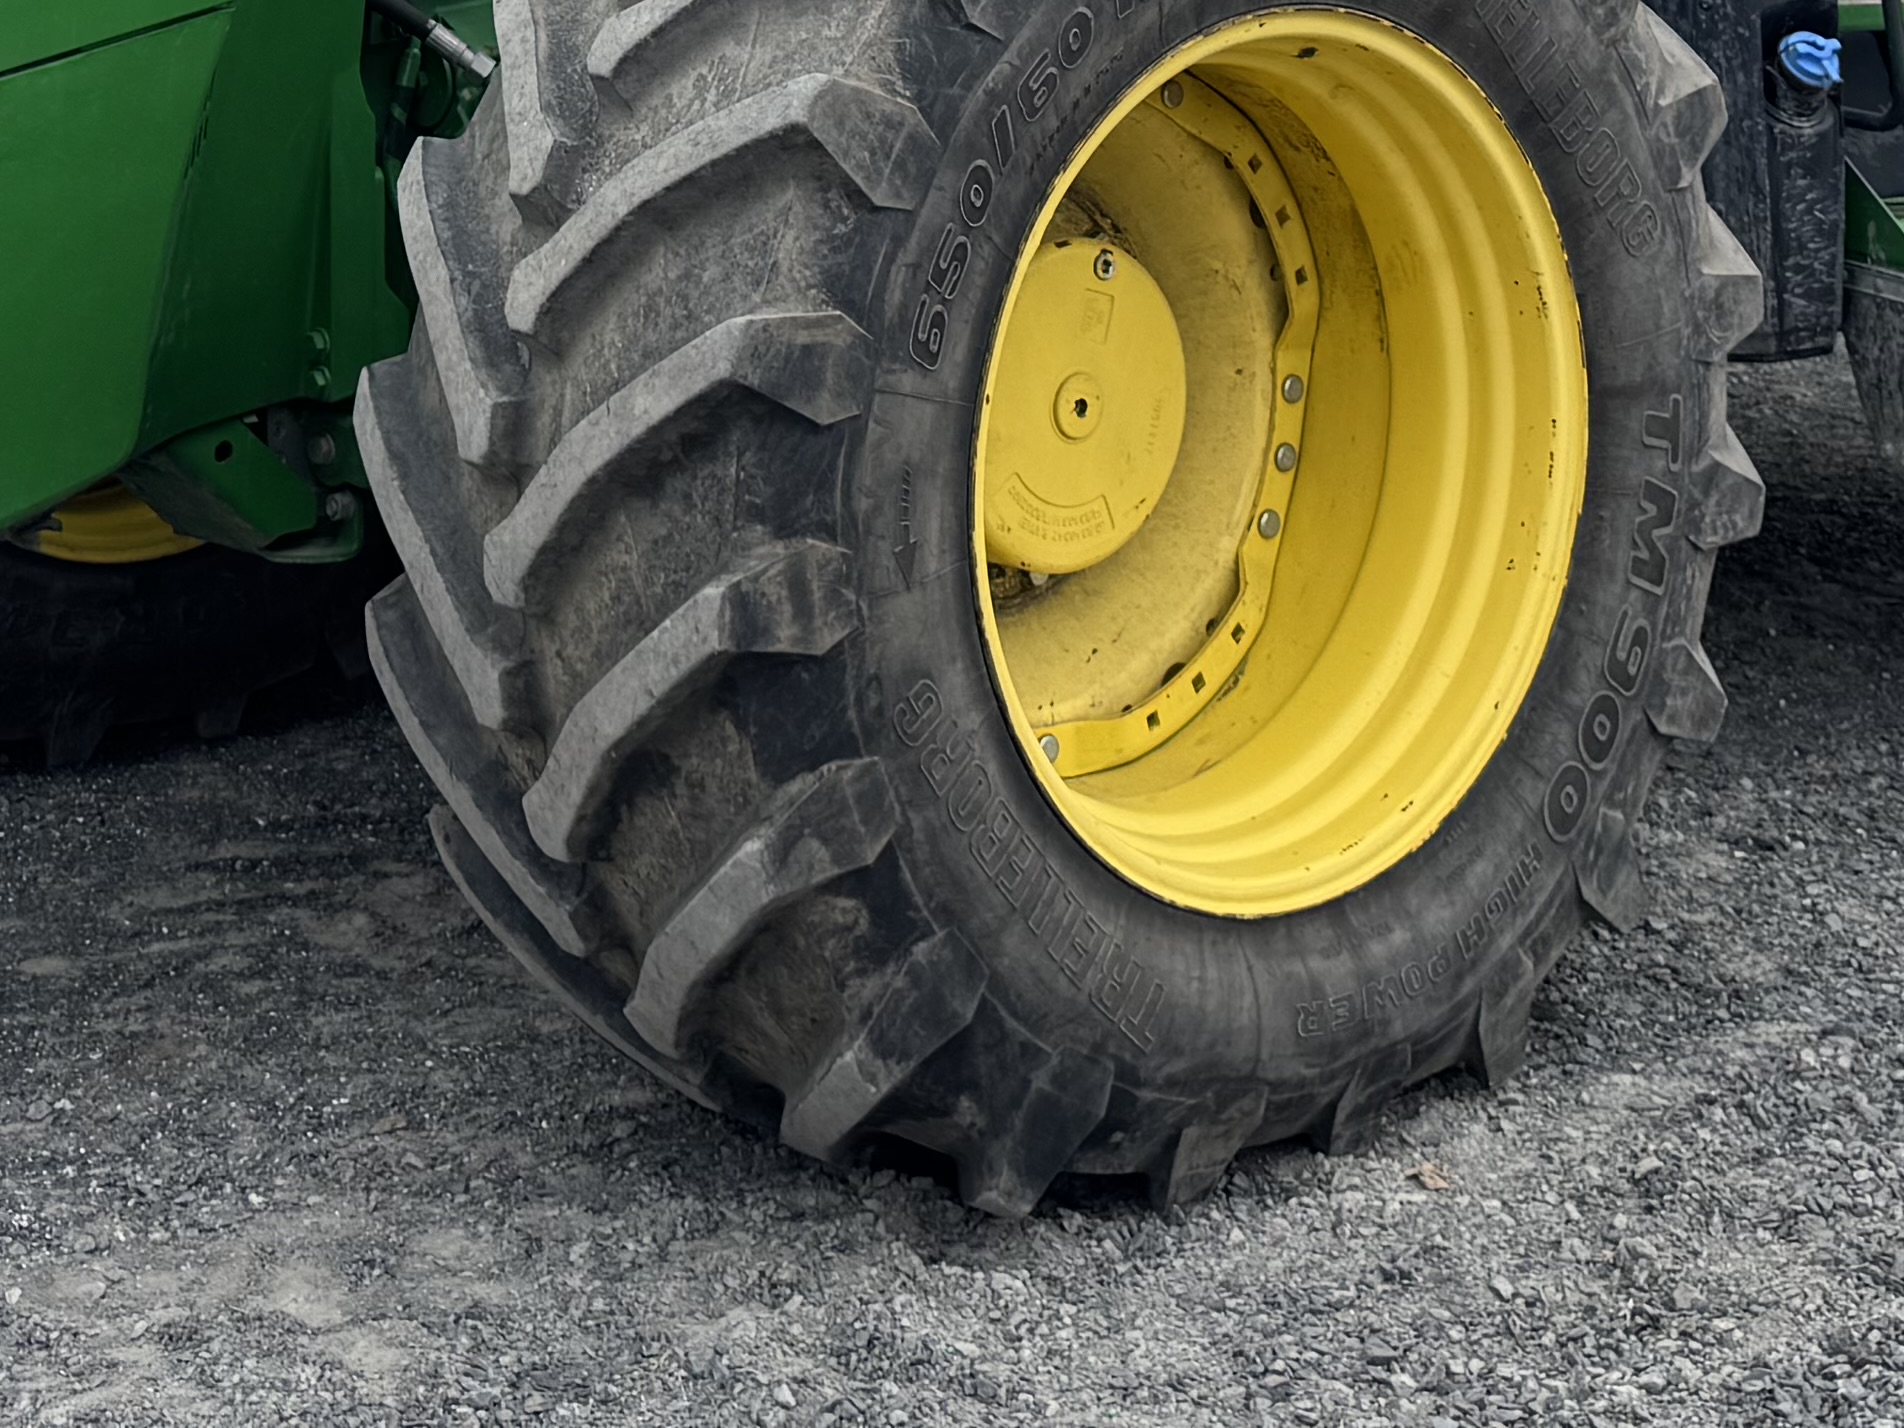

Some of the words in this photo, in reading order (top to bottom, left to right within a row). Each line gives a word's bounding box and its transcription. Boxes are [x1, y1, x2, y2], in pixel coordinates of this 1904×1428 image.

[908, 5, 1096, 371] 650/60
[893, 678, 1168, 1055] TRELLEBORG
[1455, 843, 1544, 961] HIGH
[1296, 946, 1452, 1038] POWER
